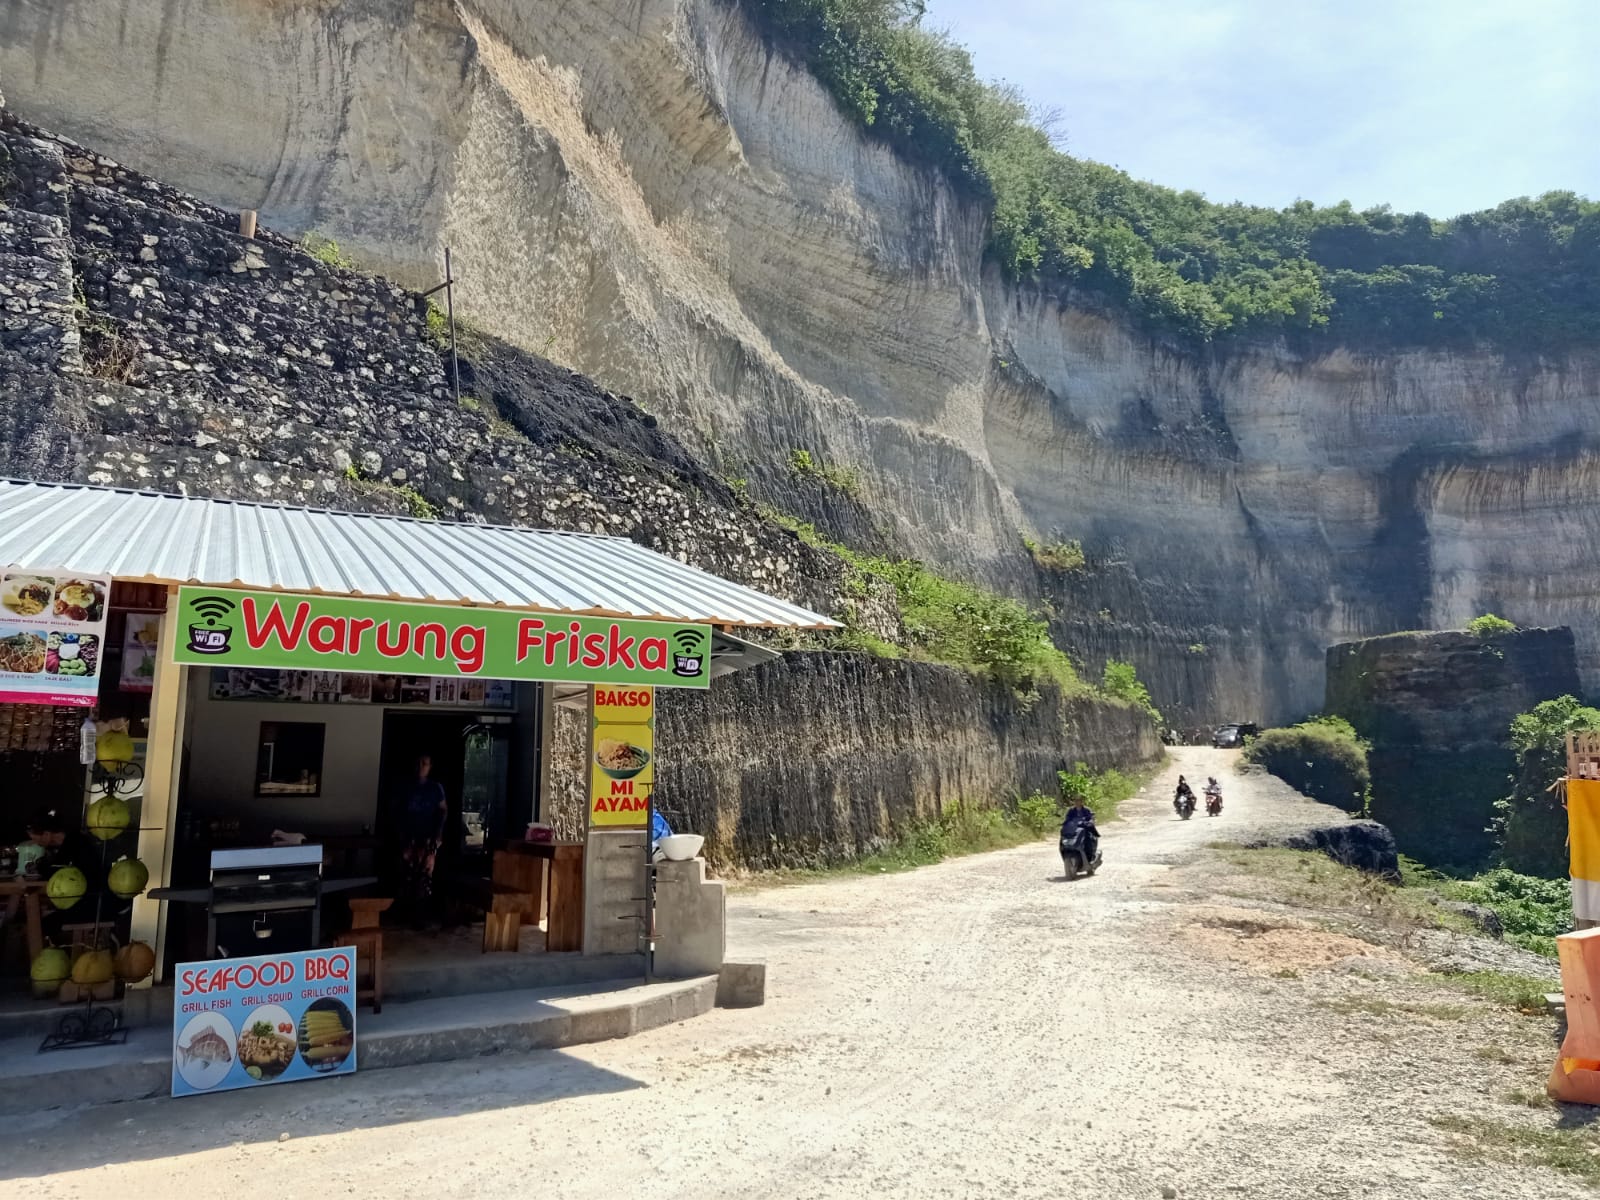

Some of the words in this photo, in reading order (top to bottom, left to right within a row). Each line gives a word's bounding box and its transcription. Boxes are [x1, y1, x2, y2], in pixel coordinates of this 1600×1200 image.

[241, 597, 487, 673] Warung
[516, 618, 669, 672] Friska
[595, 690, 651, 707] BAKSO
[611, 780, 633, 795] MI
[594, 797, 649, 812] AYAM
[182, 961, 294, 995] SEAFOOD
[305, 954, 350, 981] BBQ
[241, 996, 265, 1006] GRILL
[267, 992, 293, 1003] SQUID
[301, 989, 325, 999] GRILL
[326, 985, 349, 995] CORN
[182, 1003, 209, 1013] GRILL
[211, 999, 232, 1009] FISH
